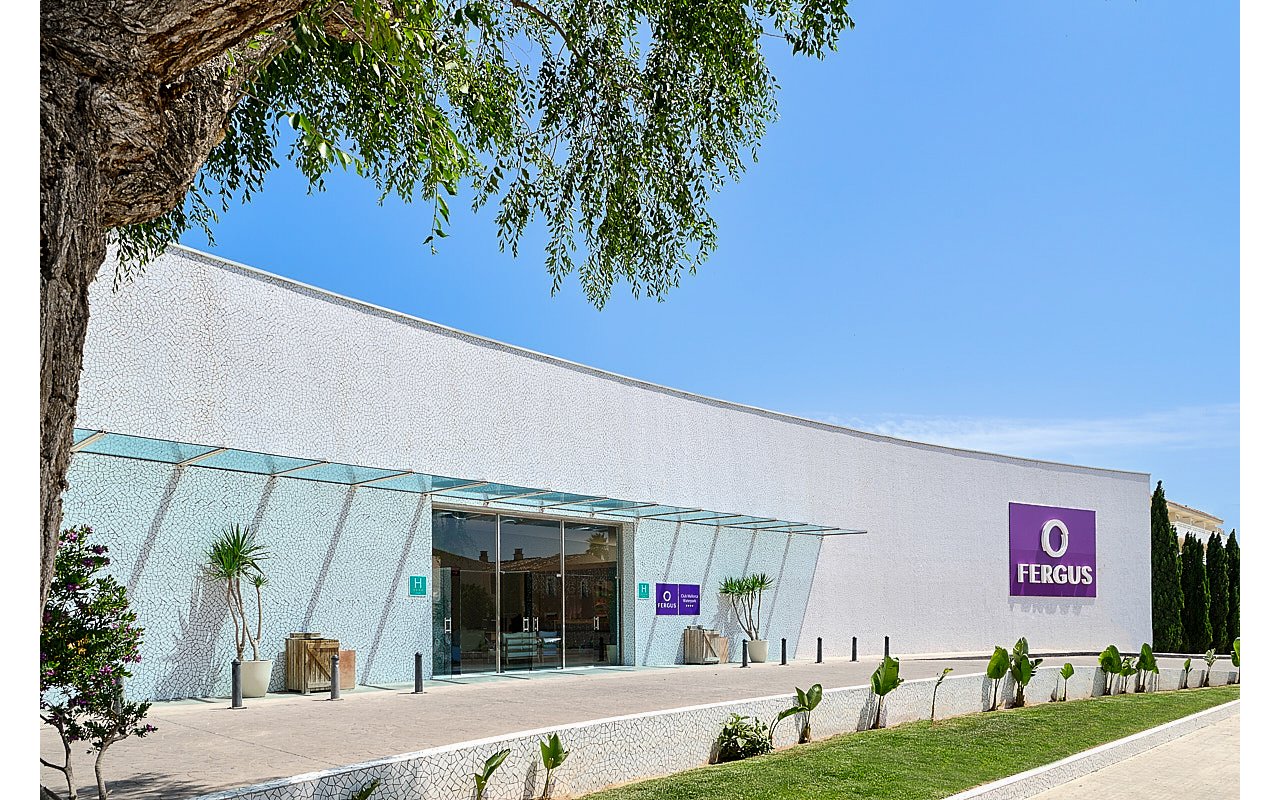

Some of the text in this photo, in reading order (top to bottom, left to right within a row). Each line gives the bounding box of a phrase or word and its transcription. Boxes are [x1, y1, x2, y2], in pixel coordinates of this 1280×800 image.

[1017, 563, 1093, 585] FERGUS
[414, 578, 422, 588] H
[641, 584, 647, 592] H
